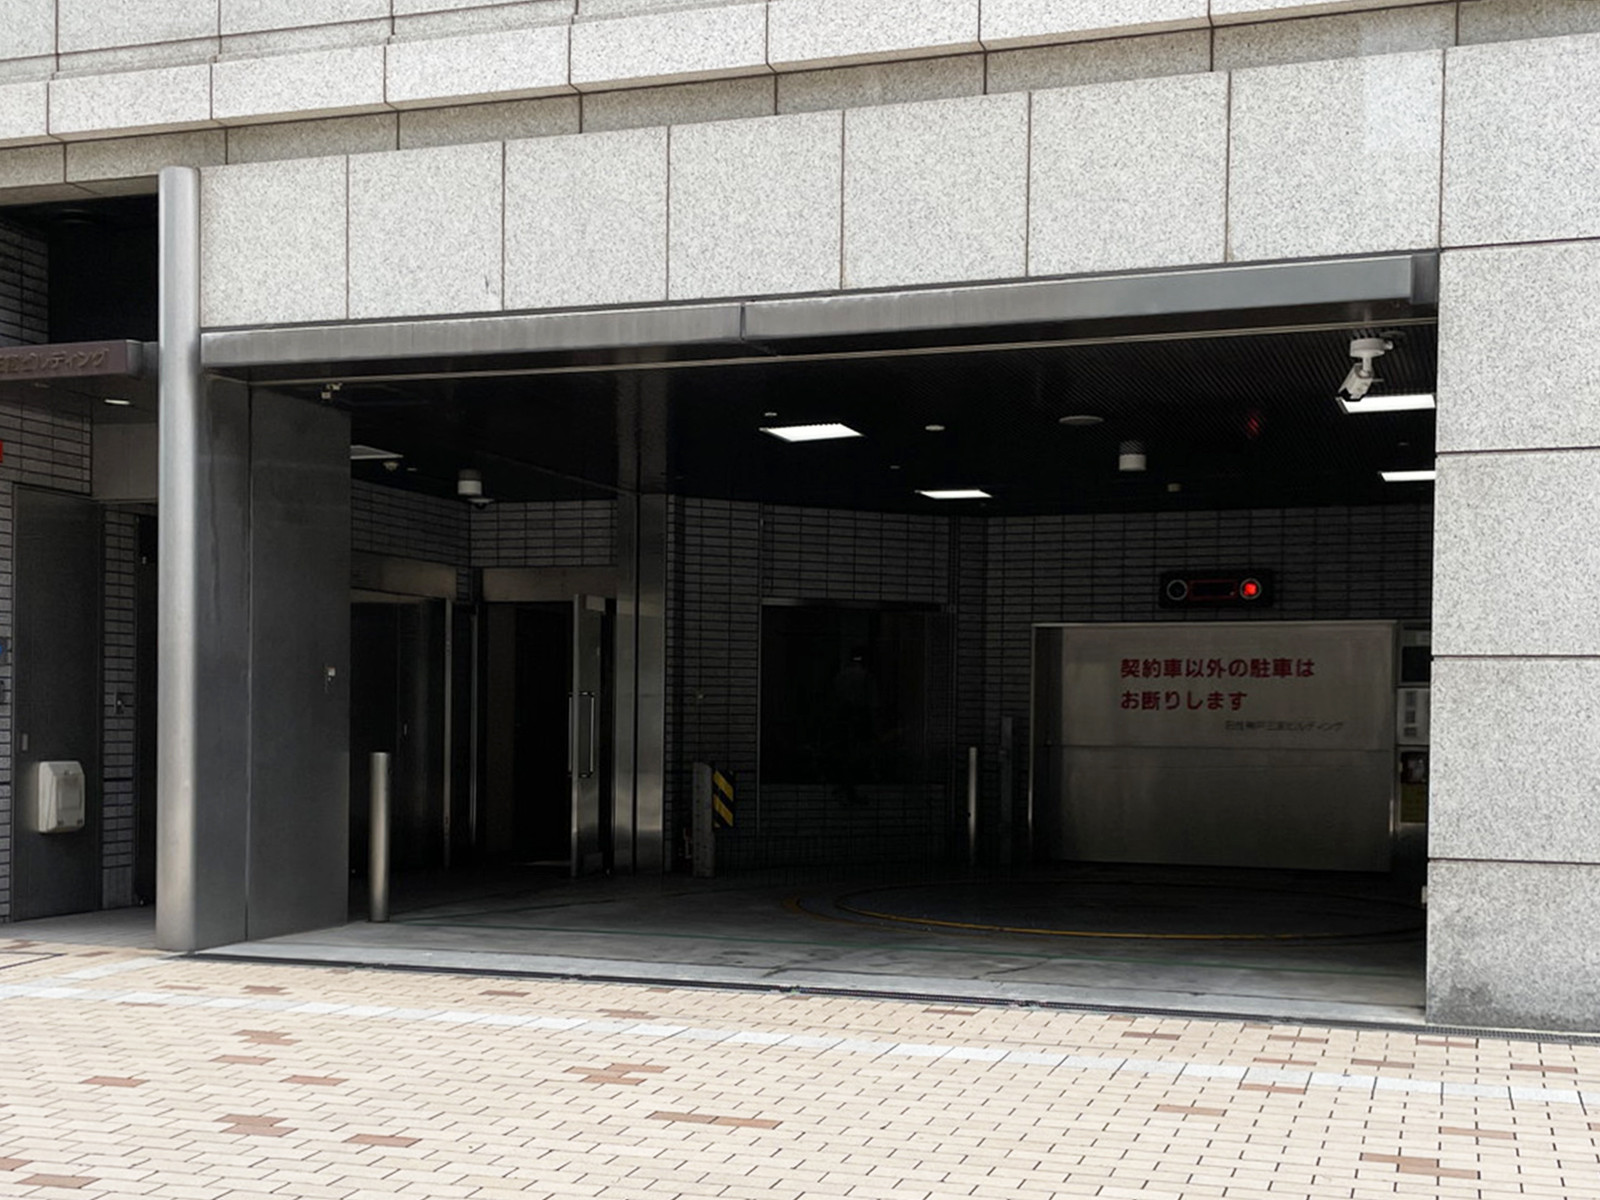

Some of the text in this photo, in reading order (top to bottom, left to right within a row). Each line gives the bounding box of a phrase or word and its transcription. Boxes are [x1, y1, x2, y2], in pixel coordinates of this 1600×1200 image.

[1120, 658, 1315, 678] 契約車以外の駐車は
[1120, 690, 1248, 711] お断りします
